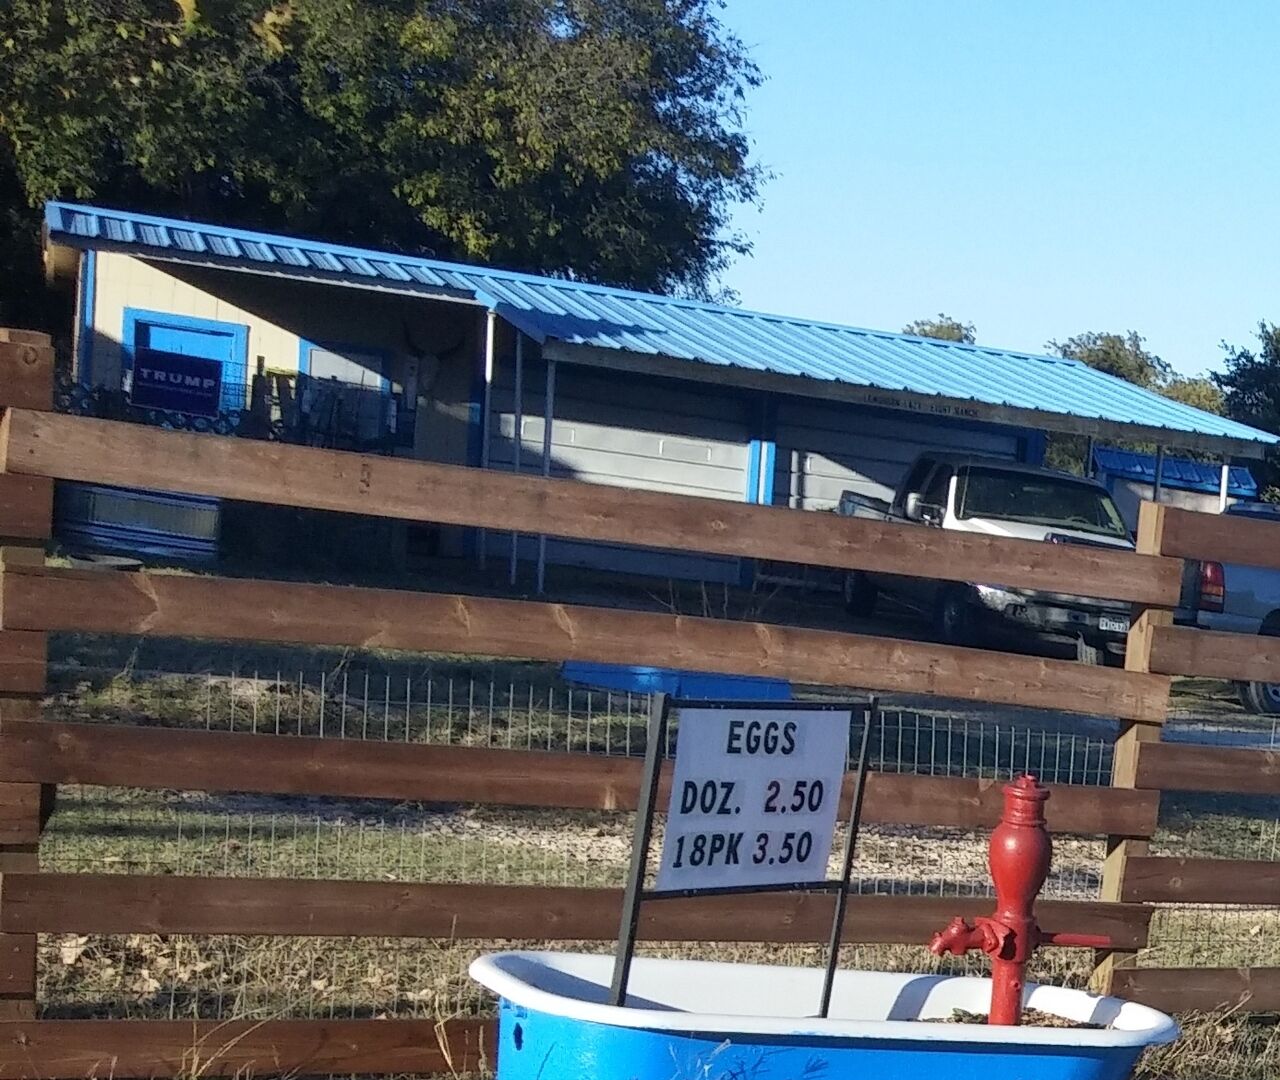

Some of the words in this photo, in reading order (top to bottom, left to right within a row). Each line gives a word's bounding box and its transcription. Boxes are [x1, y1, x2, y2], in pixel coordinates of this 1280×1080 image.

[140, 367, 216, 389] TRUMP
[726, 720, 797, 755] EGGS
[680, 780, 742, 815] DOZ.
[764, 780, 824, 814] 2.50
[672, 832, 744, 868] 18PK
[752, 832, 813, 865] 3.50
